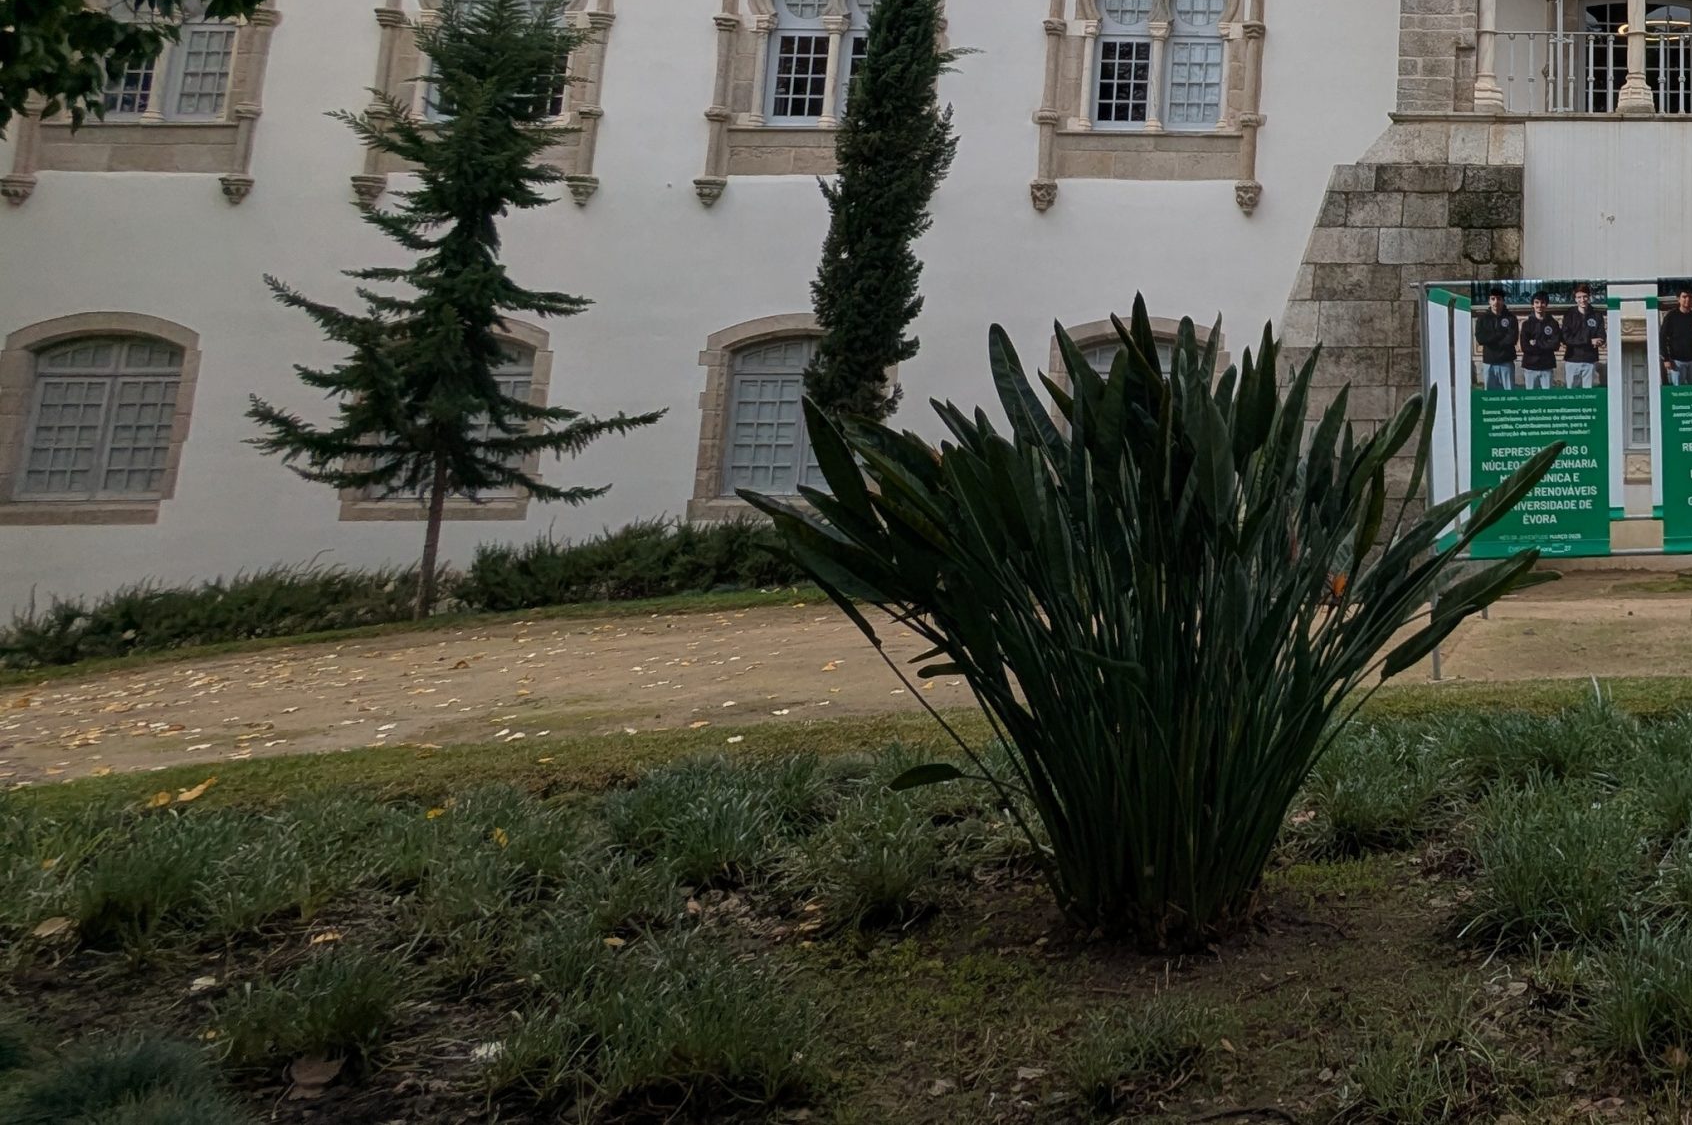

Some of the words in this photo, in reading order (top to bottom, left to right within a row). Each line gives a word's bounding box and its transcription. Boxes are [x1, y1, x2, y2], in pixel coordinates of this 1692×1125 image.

[1581, 446, 1587, 455] O
[1482, 461, 1520, 471] NÚCLEO
[1573, 473, 1580, 482] E
[1534, 486, 1597, 497] RENOVÁVEIS
[1510, 500, 1577, 511] IVERSIDADE
[1579, 500, 1592, 509] DE
[1523, 514, 1557, 525] ÉVORA
